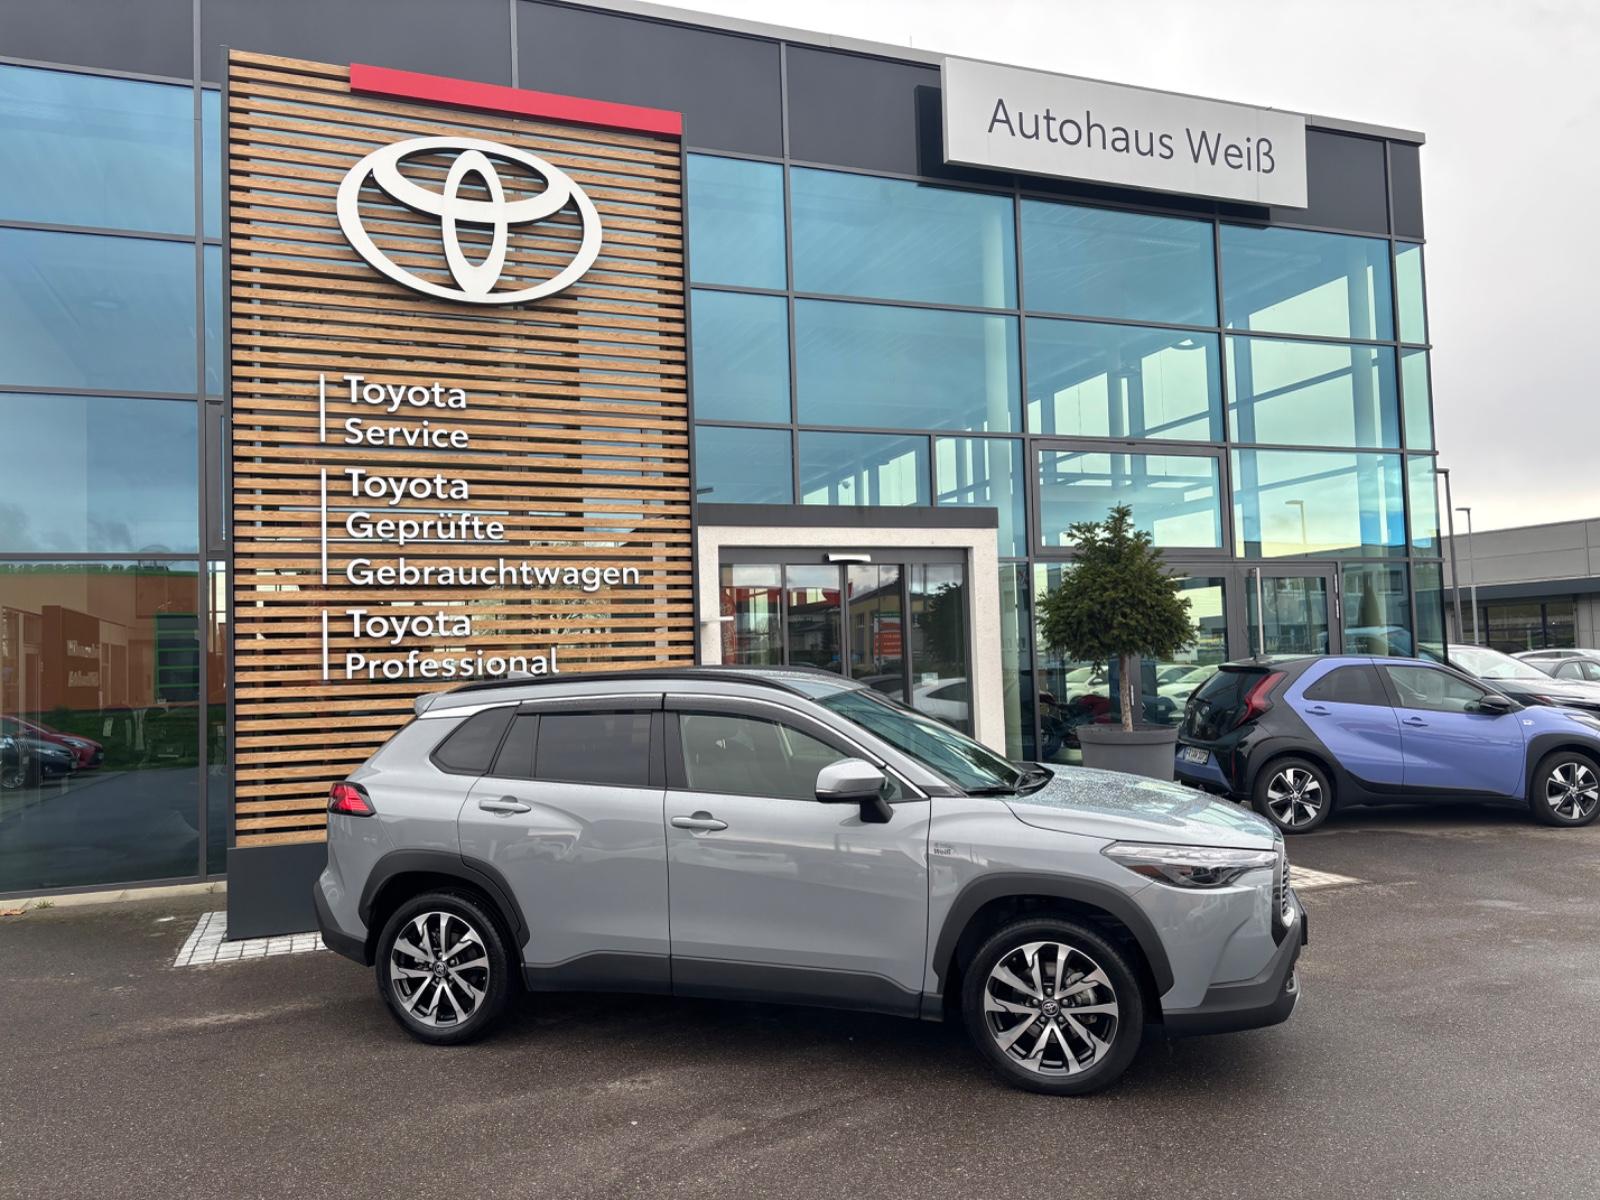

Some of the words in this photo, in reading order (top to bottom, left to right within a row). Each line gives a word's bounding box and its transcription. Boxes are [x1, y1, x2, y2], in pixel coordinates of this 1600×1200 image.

[988, 98, 1174, 160] Autohaus
[1185, 127, 1276, 174] Weiß
[343, 374, 467, 412] Toyota
[344, 418, 469, 448] Service
[344, 468, 469, 505] Toyota
[346, 512, 505, 545] Geprüfte
[346, 557, 641, 592] Gebrauchtwagen
[346, 609, 472, 645] Toyota
[346, 647, 560, 680] Professional
